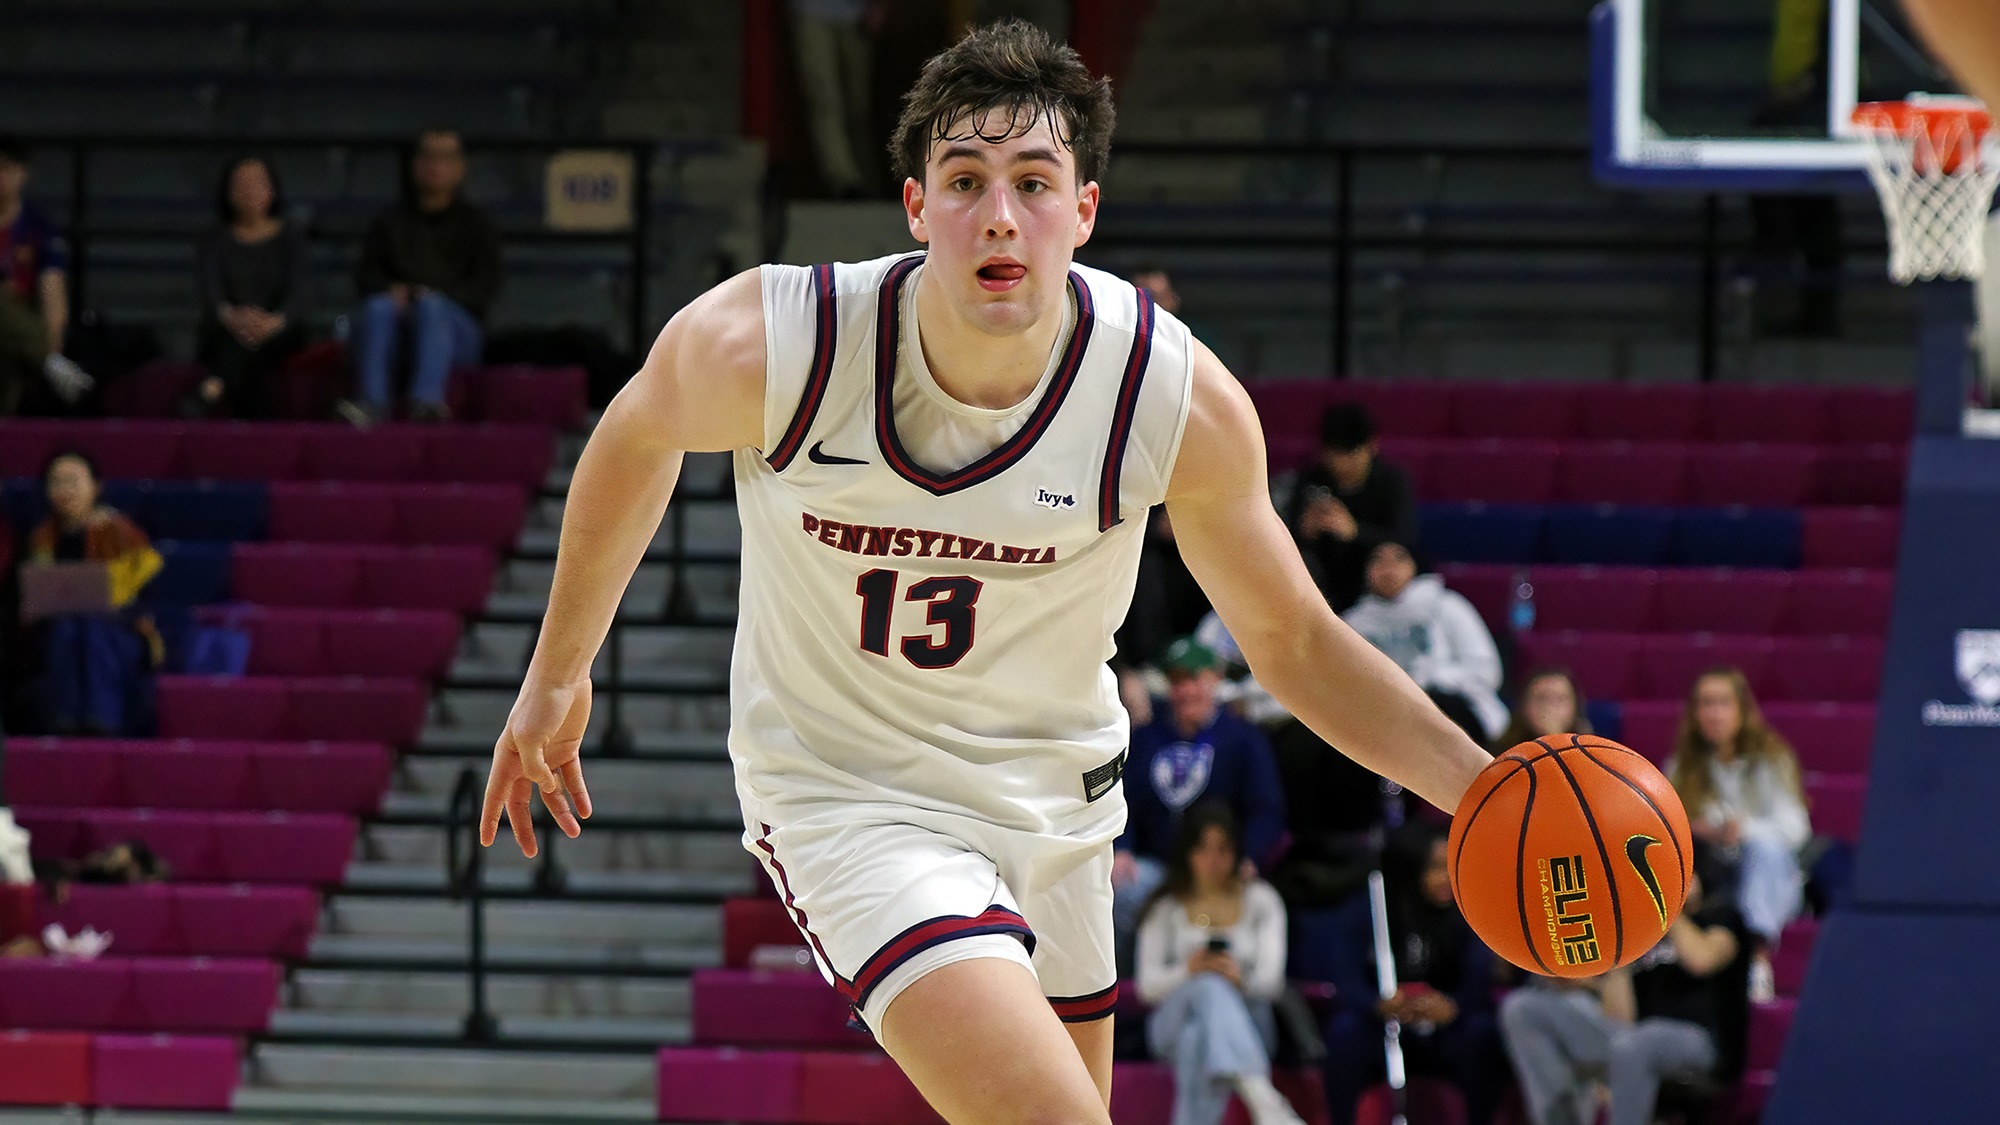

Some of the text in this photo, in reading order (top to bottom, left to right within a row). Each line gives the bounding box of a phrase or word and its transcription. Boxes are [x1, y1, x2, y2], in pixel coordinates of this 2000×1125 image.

[802, 511, 1057, 564] PENNSYLVANIA
[1038, 489, 1062, 507] Ivy
[856, 568, 984, 670] 13
[1537, 858, 1564, 966] CHAMPIONSHIP
[1549, 854, 1602, 965] ELITE
